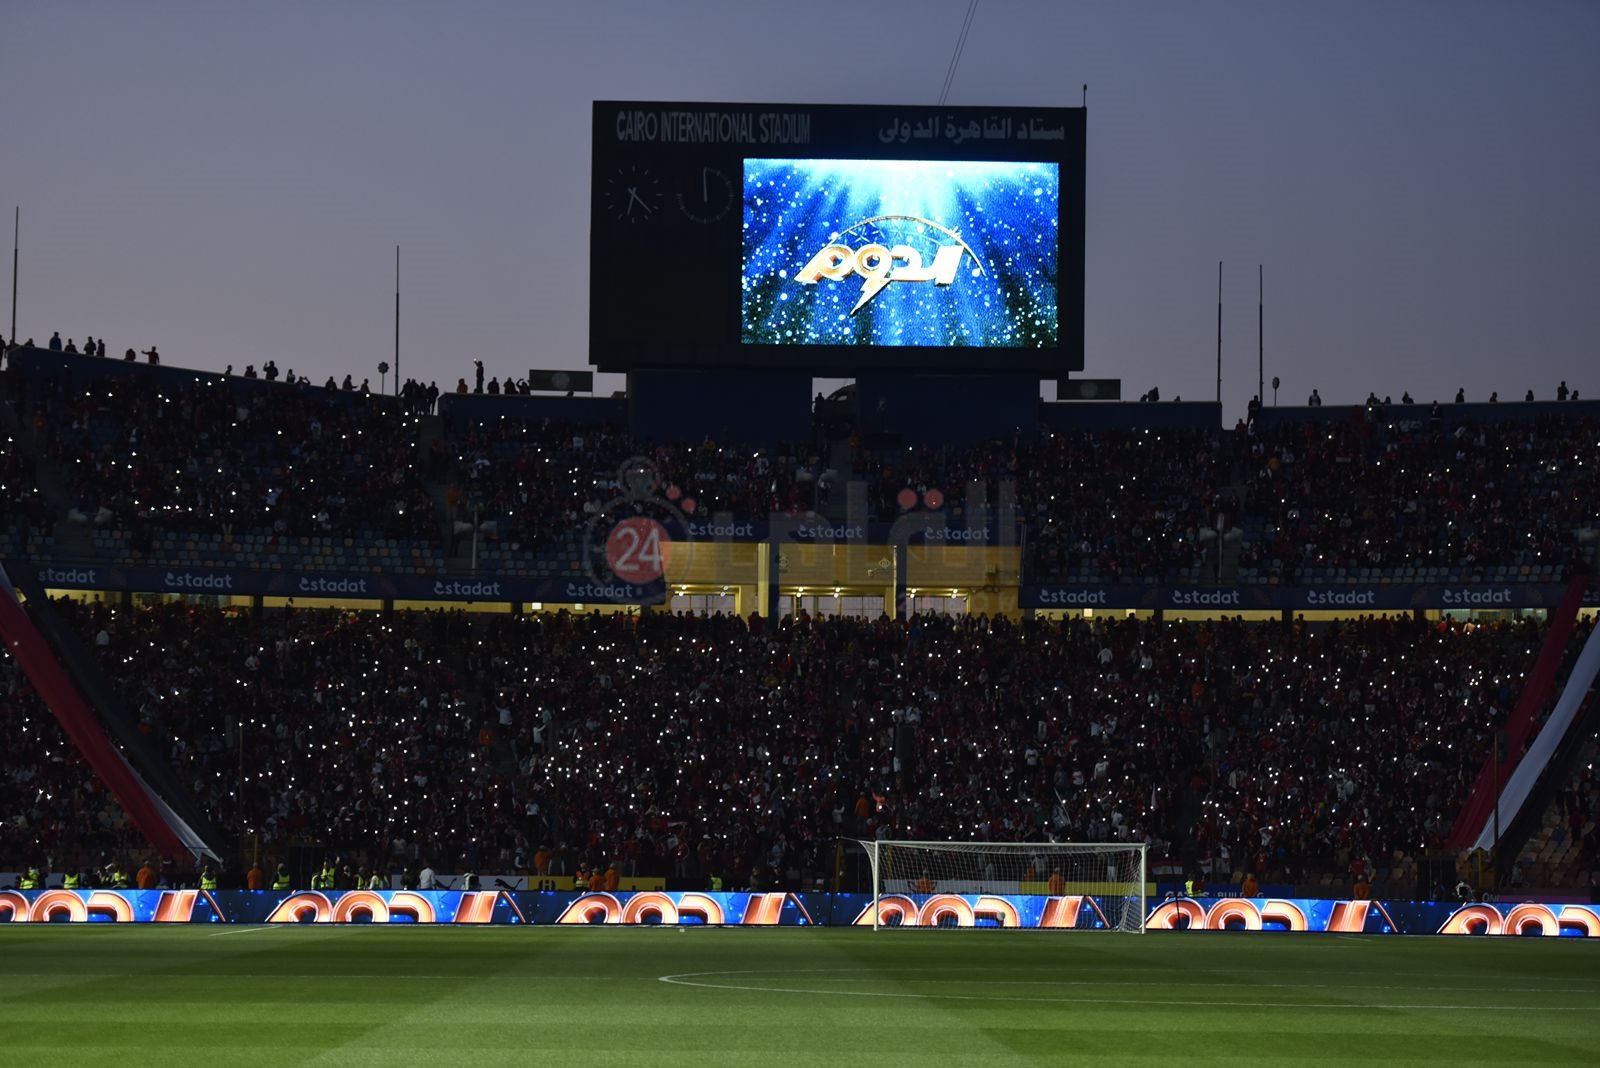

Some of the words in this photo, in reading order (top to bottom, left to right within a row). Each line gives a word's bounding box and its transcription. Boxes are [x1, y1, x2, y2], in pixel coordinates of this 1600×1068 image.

[616, 111, 658, 141] CAIRO
[660, 111, 756, 143] INTERNATIONAL
[759, 112, 811, 144] STADIUM
[944, 115, 1012, 145] القاهرة
[1016, 117, 1065, 141] ستاد
[687, 522, 753, 538] estadat
[797, 523, 863, 540] estadat
[924, 525, 991, 541] estadat
[39, 568, 96, 584] stadat
[163, 571, 233, 589] estadat
[298, 576, 367, 593] estadat
[433, 580, 501, 596] estadat
[565, 581, 633, 599] estadat
[1038, 588, 1106, 604] estadat
[1171, 588, 1240, 604] estadat
[1306, 588, 1375, 604] estadat
[1442, 588, 1511, 604] estadat
